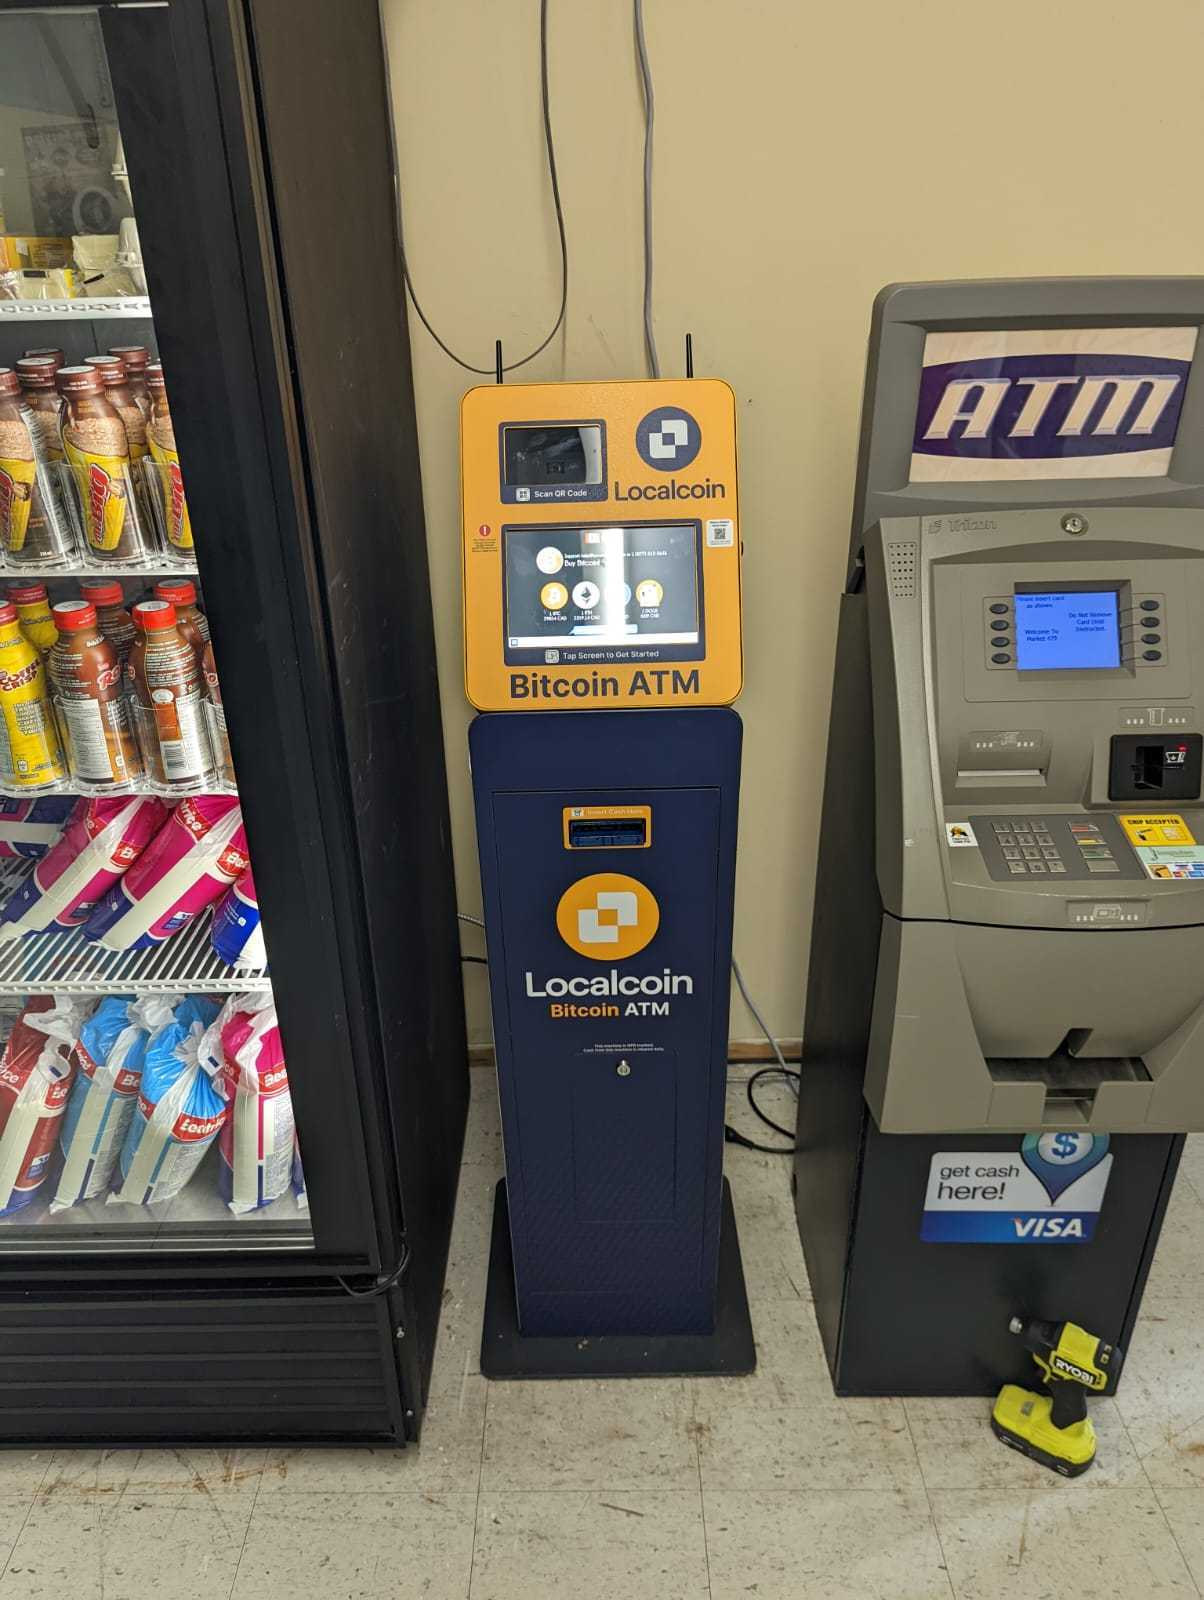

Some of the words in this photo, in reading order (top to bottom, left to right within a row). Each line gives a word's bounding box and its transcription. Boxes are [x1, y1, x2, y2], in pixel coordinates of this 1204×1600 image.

[922, 375, 1181, 440] ATM
[534, 490, 553, 498] Scan
[554, 490, 566, 498] QR
[567, 489, 588, 497] Code
[614, 478, 726, 501] Localcoin
[563, 652, 577, 661] Tap
[578, 651, 605, 659] Screen
[606, 651, 615, 659] to
[615, 650, 629, 658] Get
[631, 649, 660, 658] Started
[510, 671, 619, 699] Bitcoin
[628, 669, 700, 696] ATM
[525, 968, 693, 998] Localcoin
[550, 1003, 619, 1018] Bitcoin
[624, 1002, 670, 1016] ATM
[939, 1165, 971, 1179] get
[975, 1164, 1020, 1178] cash
[937, 1182, 1006, 1200] here!
[1013, 1217, 1083, 1238] VISA
[1055, 1358, 1094, 1385] RYOBI
